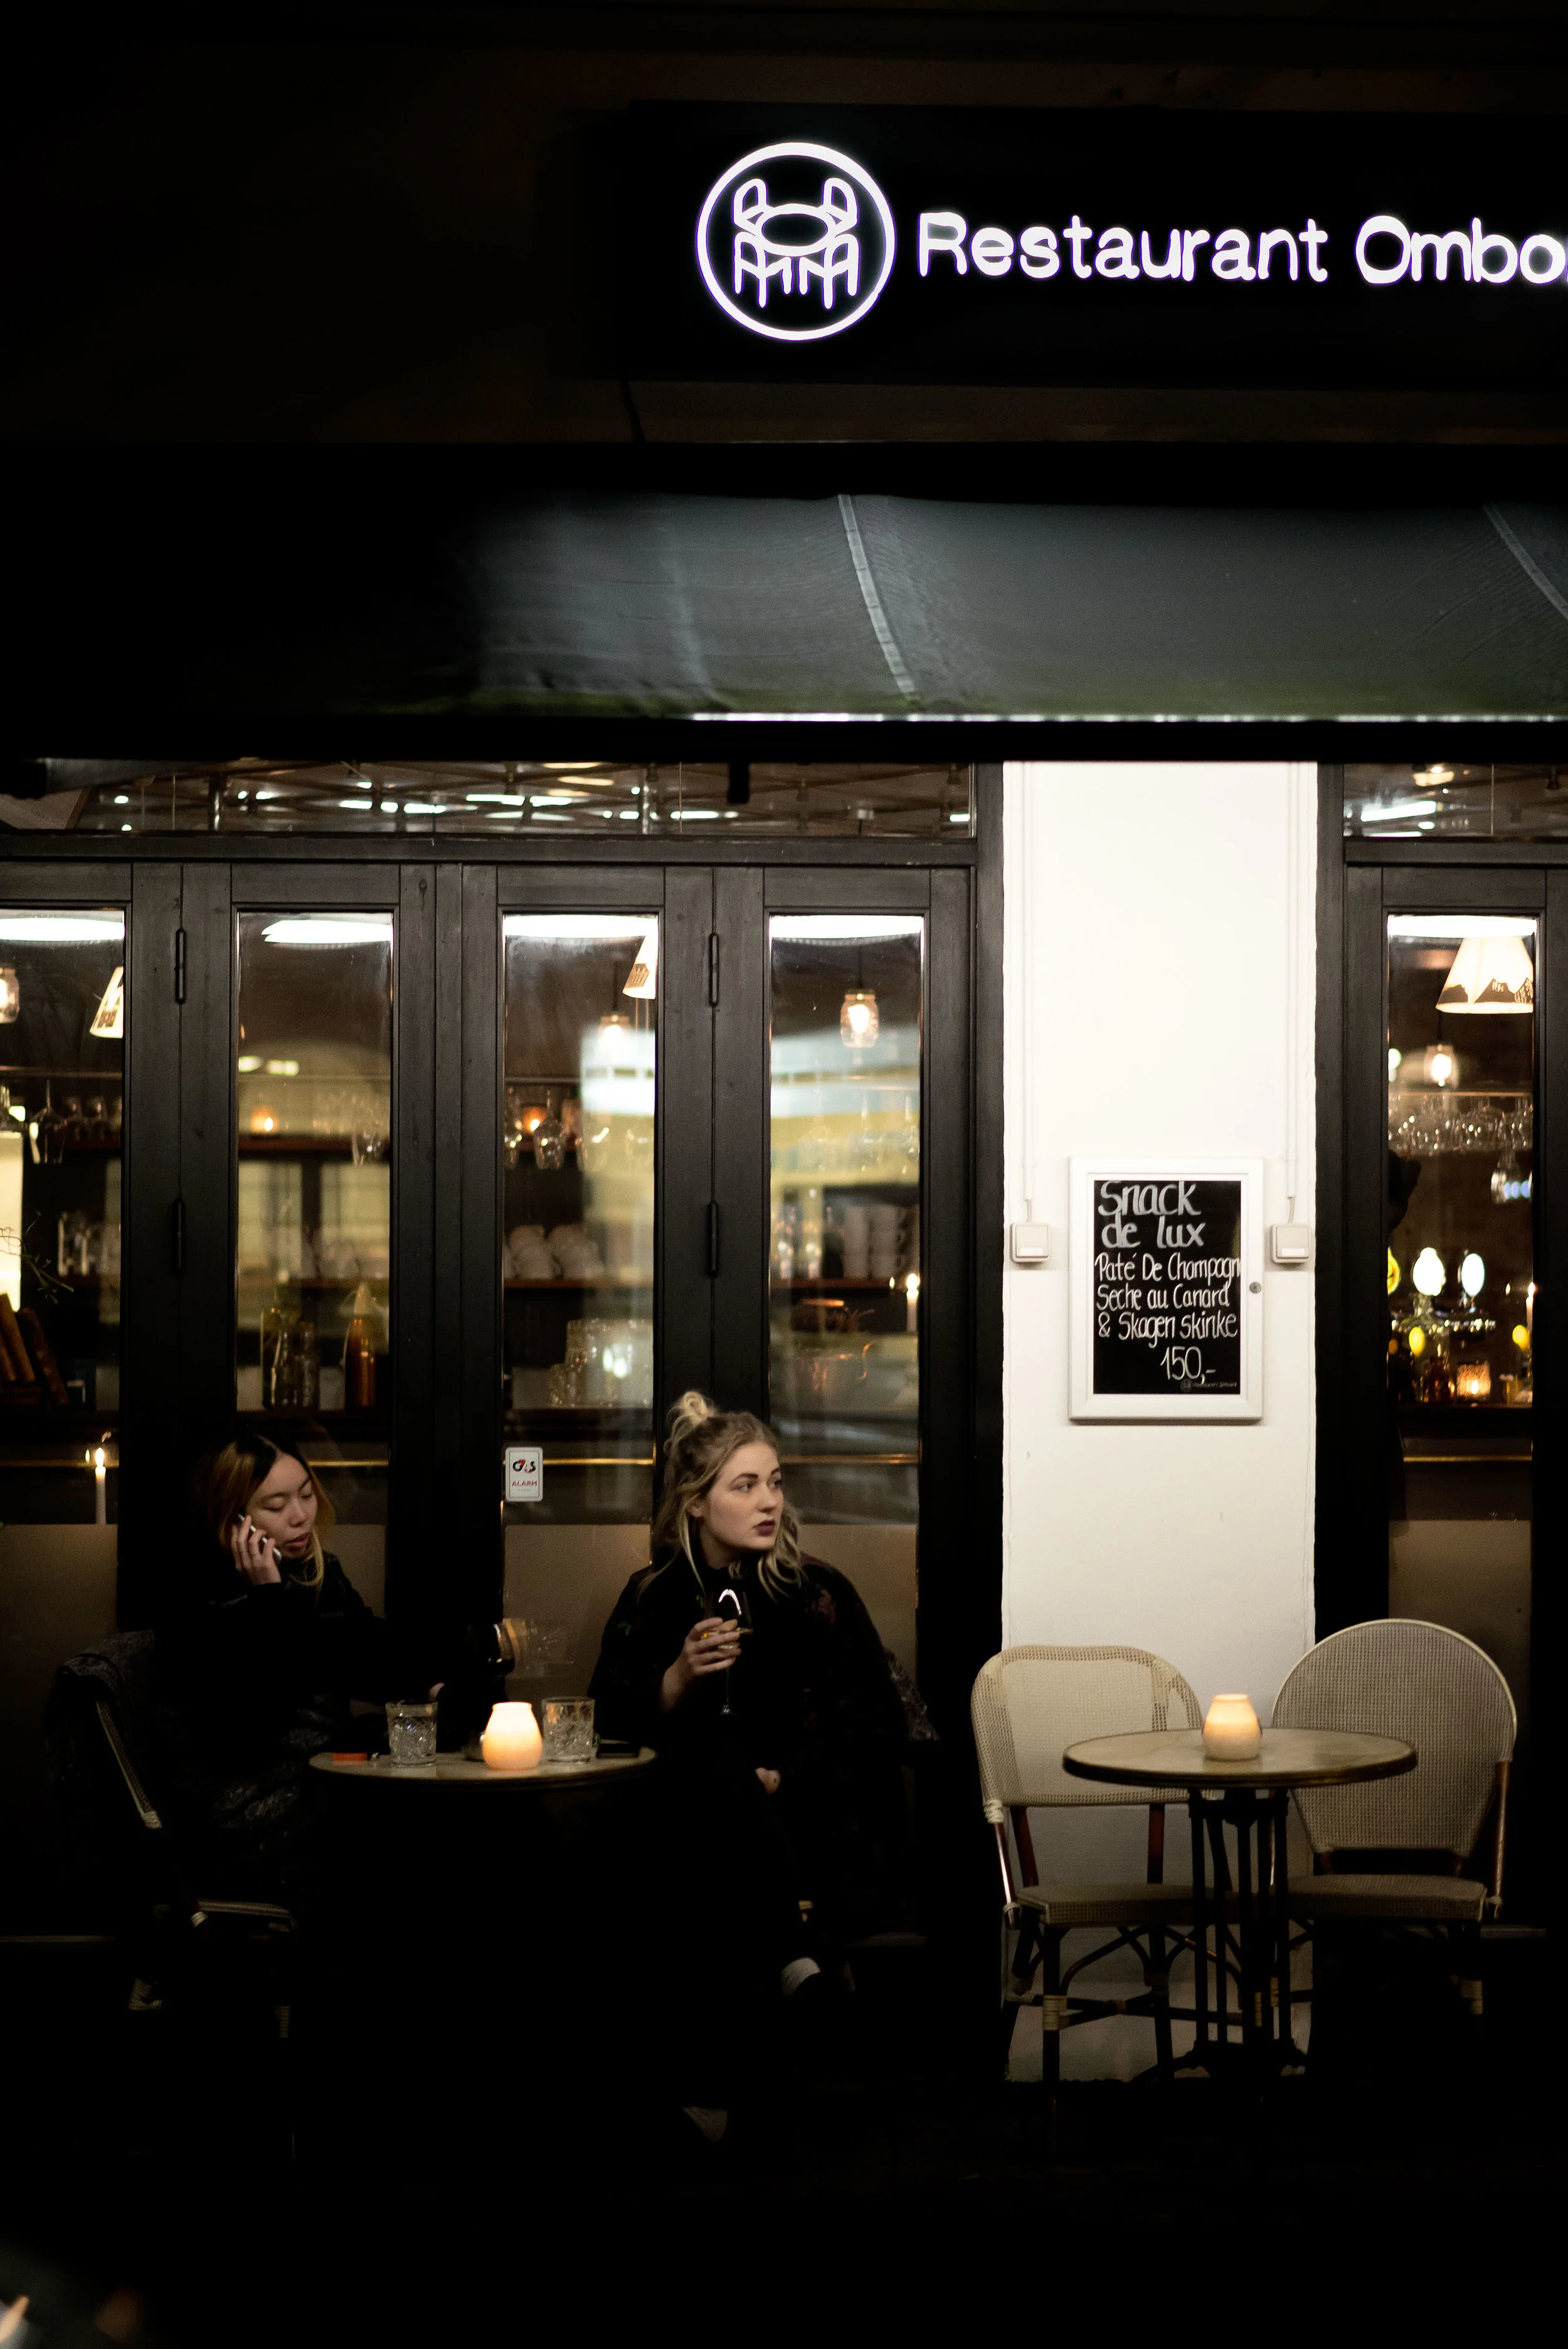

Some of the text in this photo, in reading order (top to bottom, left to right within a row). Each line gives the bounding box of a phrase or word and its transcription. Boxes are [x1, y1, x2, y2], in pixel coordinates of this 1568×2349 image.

[919, 211, 1568, 284] Restaurant Ombo
[1098, 1180, 1202, 1216] Snack
[1101, 1211, 1206, 1249] de lux
[1094, 1252, 1137, 1281] Paté
[1142, 1253, 1162, 1281] De
[1096, 1281, 1230, 1311] Seche au Canard
[1098, 1311, 1111, 1338] &
[1118, 1311, 1176, 1348] Skagen
